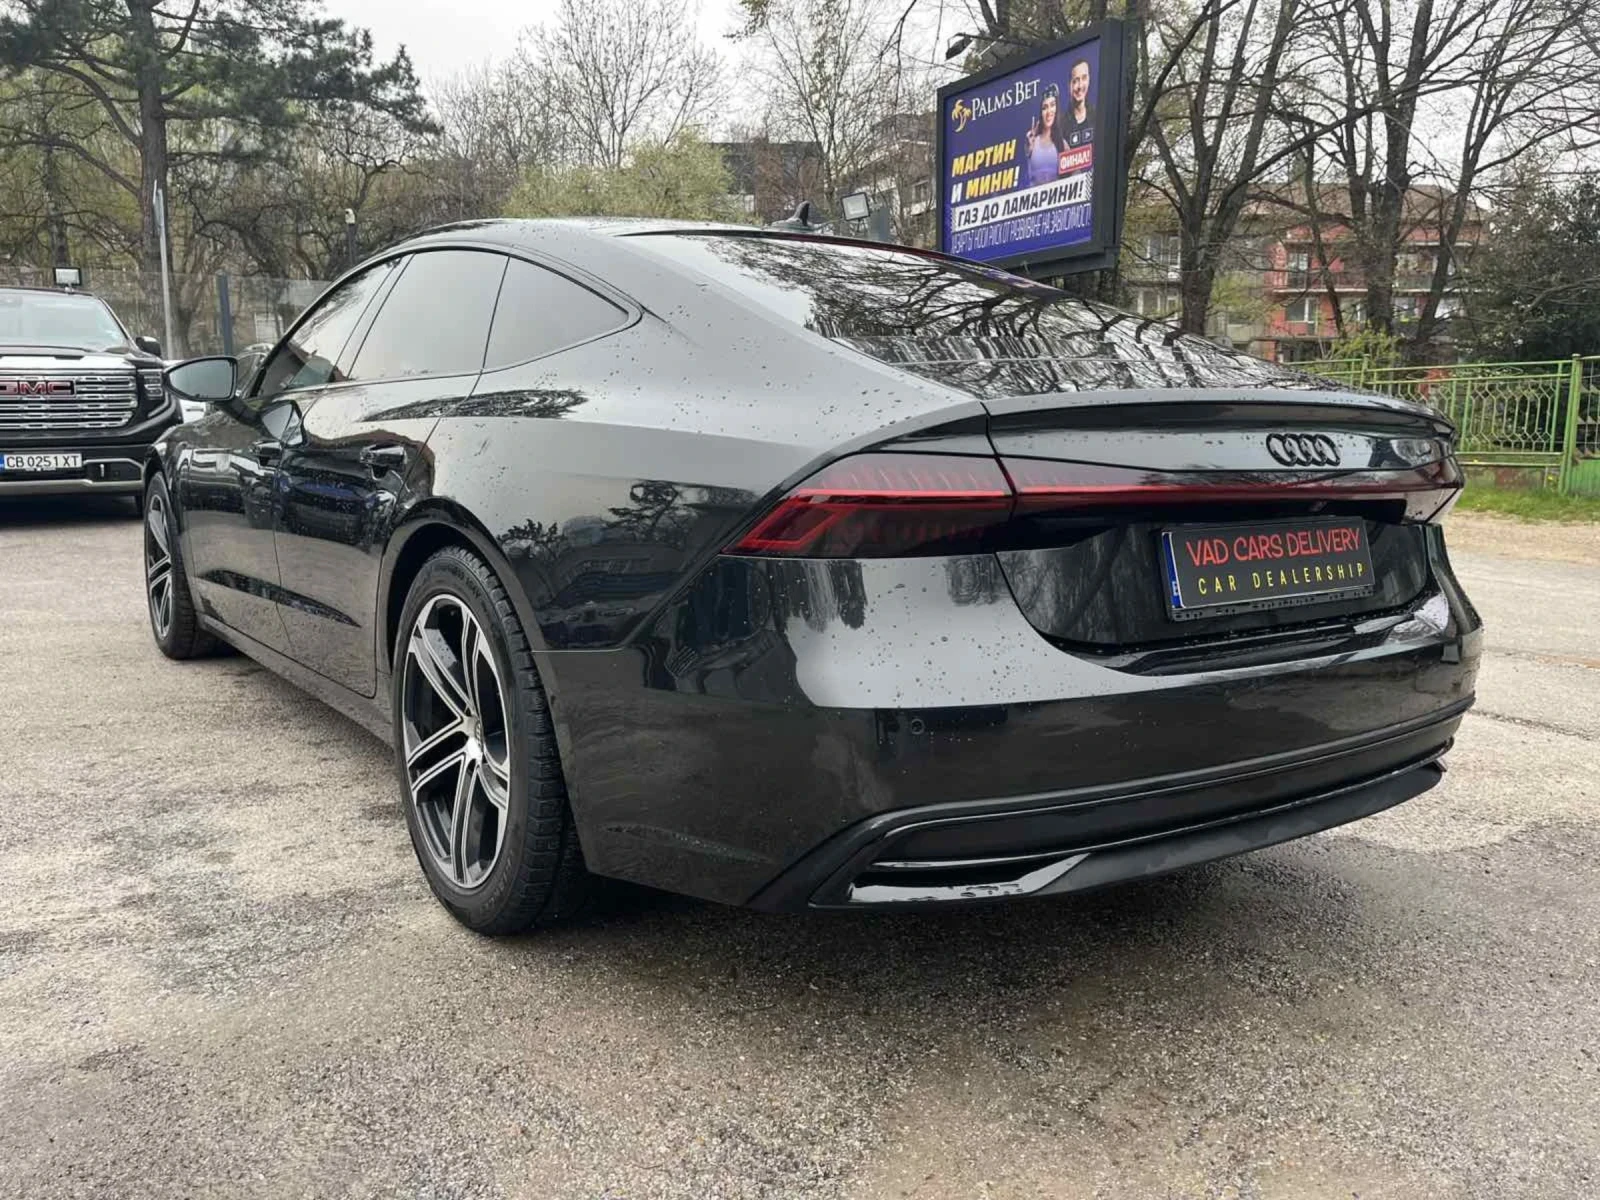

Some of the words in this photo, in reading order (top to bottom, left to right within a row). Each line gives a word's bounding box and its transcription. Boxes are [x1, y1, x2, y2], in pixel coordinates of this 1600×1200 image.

[971, 89, 1013, 121] PALMS
[1015, 79, 1040, 105] BET
[952, 138, 1017, 178] МАРТИН
[1060, 149, 1090, 170] ФИНАЛ!
[951, 182, 963, 204] И
[965, 165, 1020, 200] МИНИ!
[957, 207, 979, 227] ГАЗ
[981, 202, 999, 223] ДО
[1002, 179, 1084, 217] ЛАМАРИНИ!
[6, 455, 25, 468] CB
[27, 455, 59, 468] 0251
[62, 455, 79, 467] XT
[1186, 539, 1229, 567] VAD
[1233, 533, 1284, 562] CARS
[1286, 527, 1361, 557] DELIVERY
[1198, 575, 1237, 595] CAR
[1252, 562, 1365, 589] DEALERSHIP
